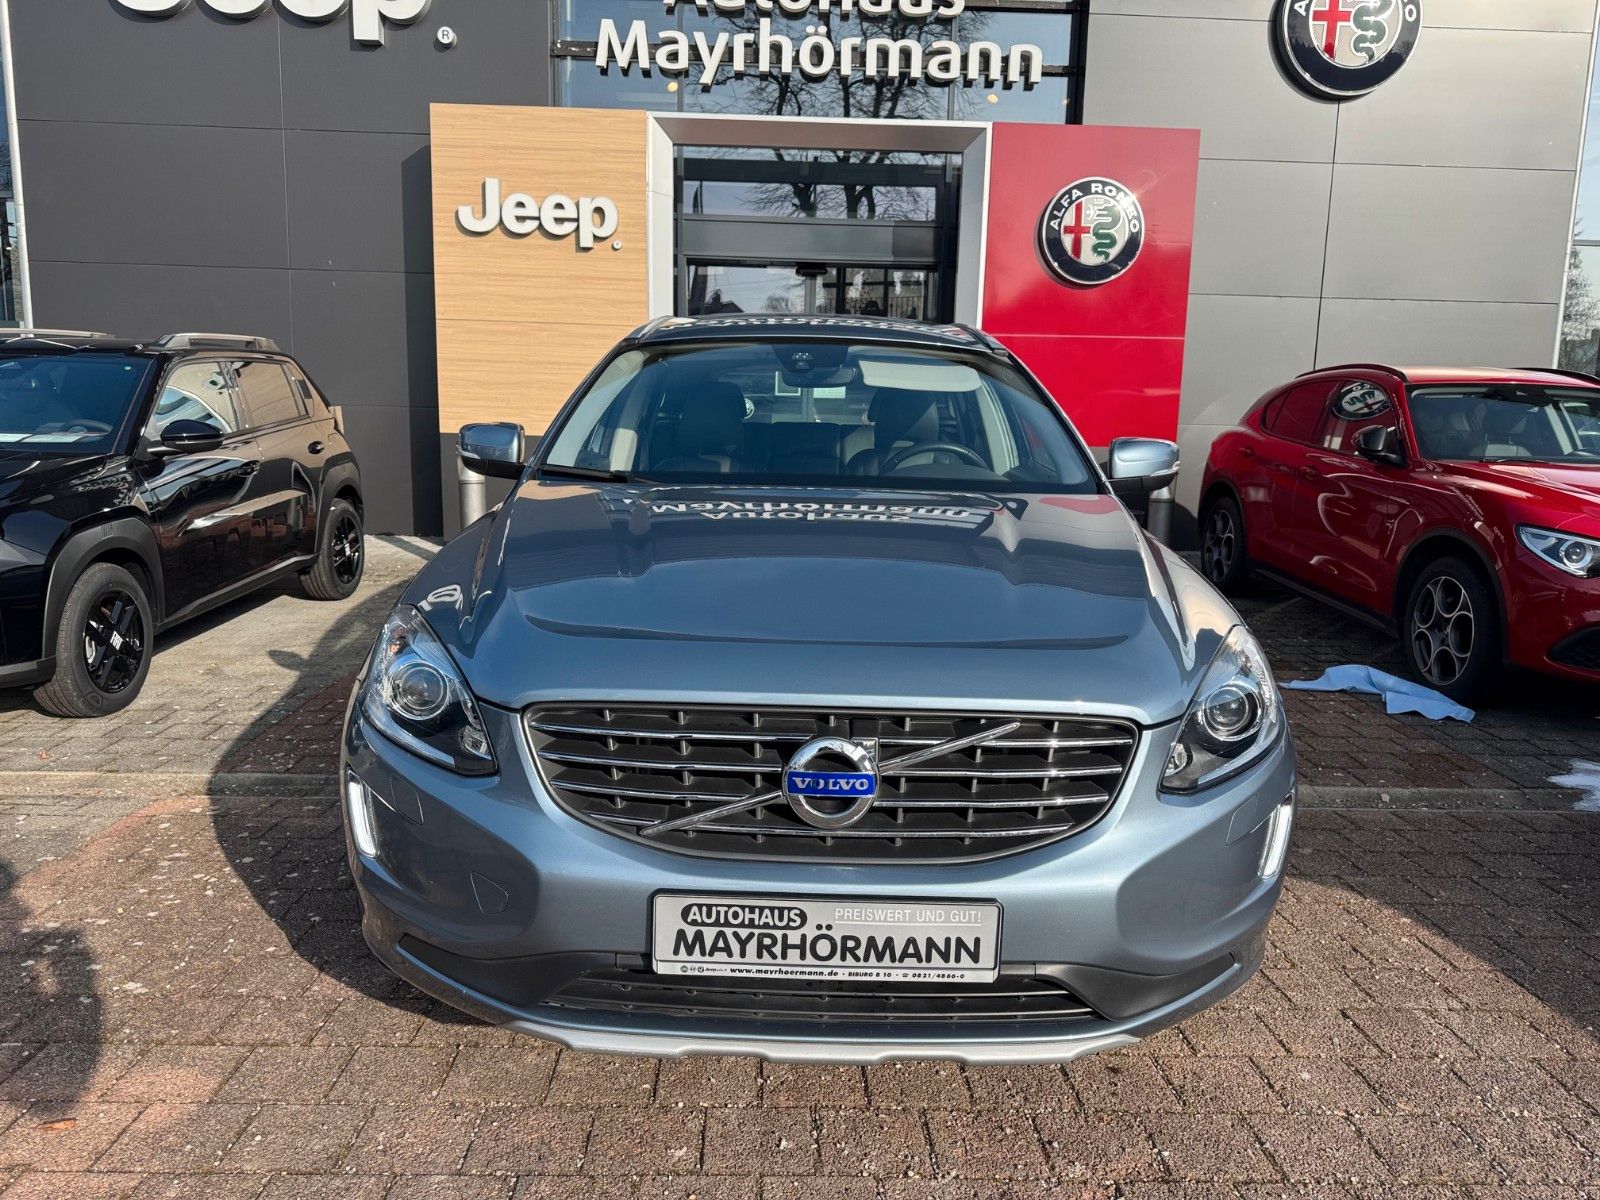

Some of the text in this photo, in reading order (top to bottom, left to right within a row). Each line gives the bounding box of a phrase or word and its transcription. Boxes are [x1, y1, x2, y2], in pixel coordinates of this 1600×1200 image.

[595, 18, 1043, 88] Mayrhörmann
[457, 177, 619, 249] Jeep
[1049, 188, 1084, 231] ALFA
[792, 777, 869, 790] VOLVO
[686, 904, 982, 928] AUTOHAUS PREISWERT UND GUT!
[672, 924, 981, 964] MAYRHÖRMANN
[730, 966, 839, 978] www.mayrhoermann.de
